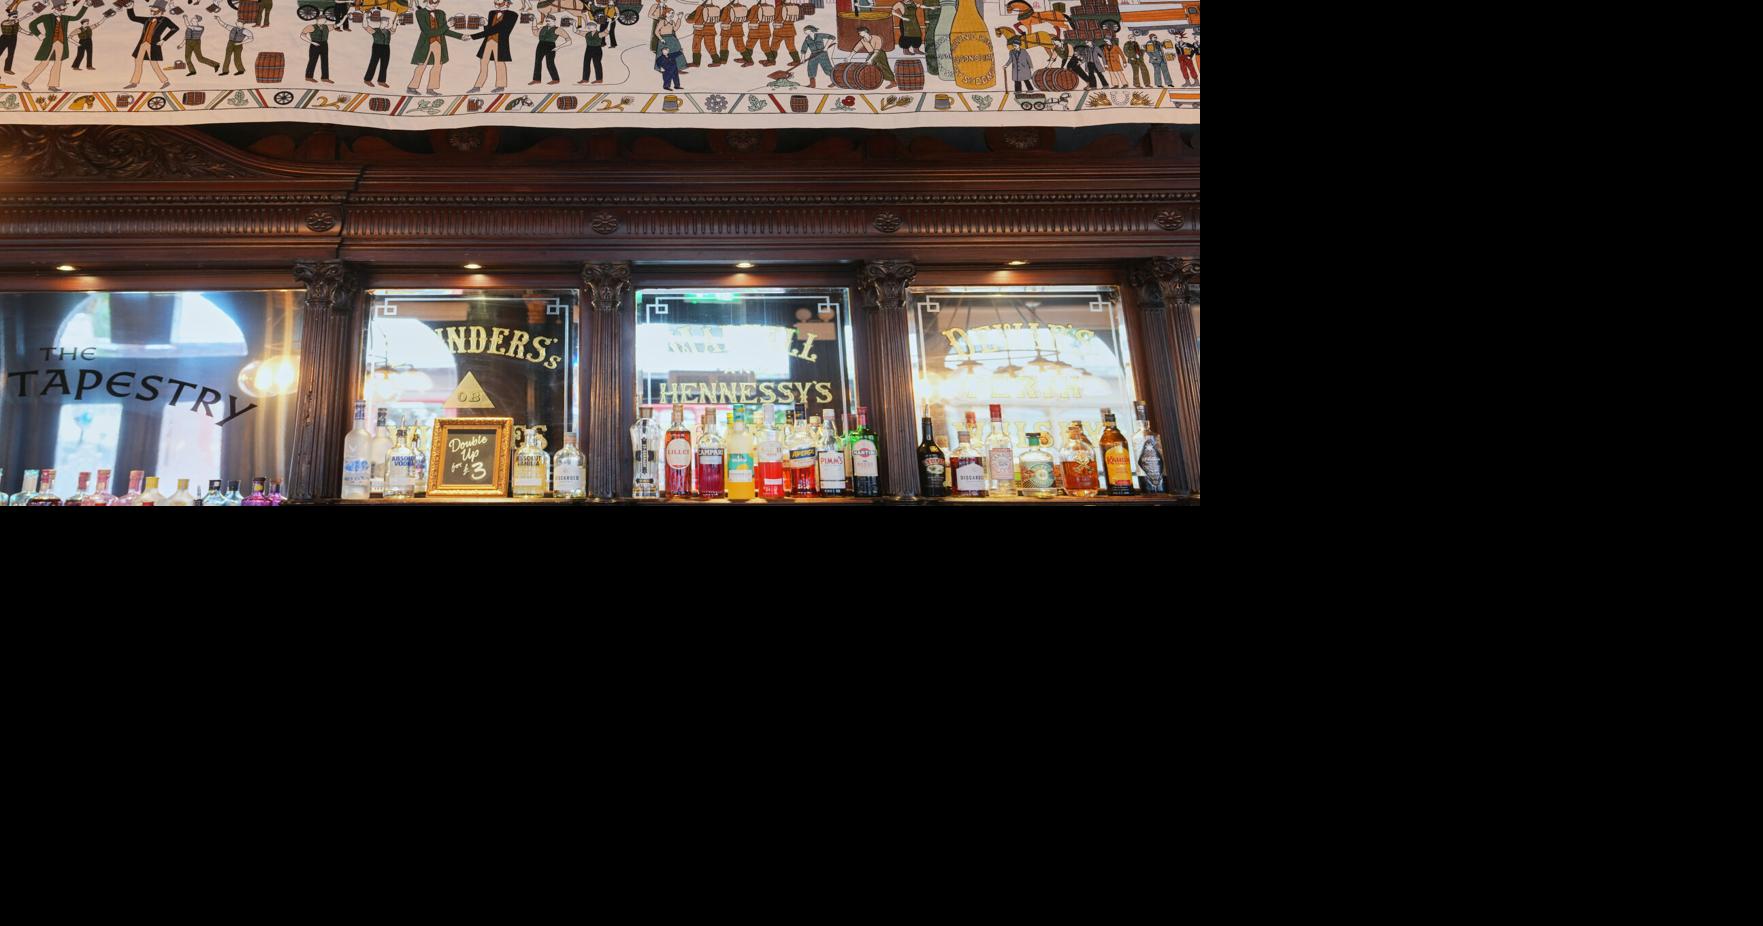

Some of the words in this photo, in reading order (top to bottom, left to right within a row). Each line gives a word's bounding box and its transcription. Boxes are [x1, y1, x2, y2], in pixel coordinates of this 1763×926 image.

[40, 347, 97, 361] THE
[8, 369, 258, 427] TAPESTRY
[659, 380, 833, 404] HENNESSY'S
[449, 434, 488, 453] Double
[460, 449, 479, 463] Up
